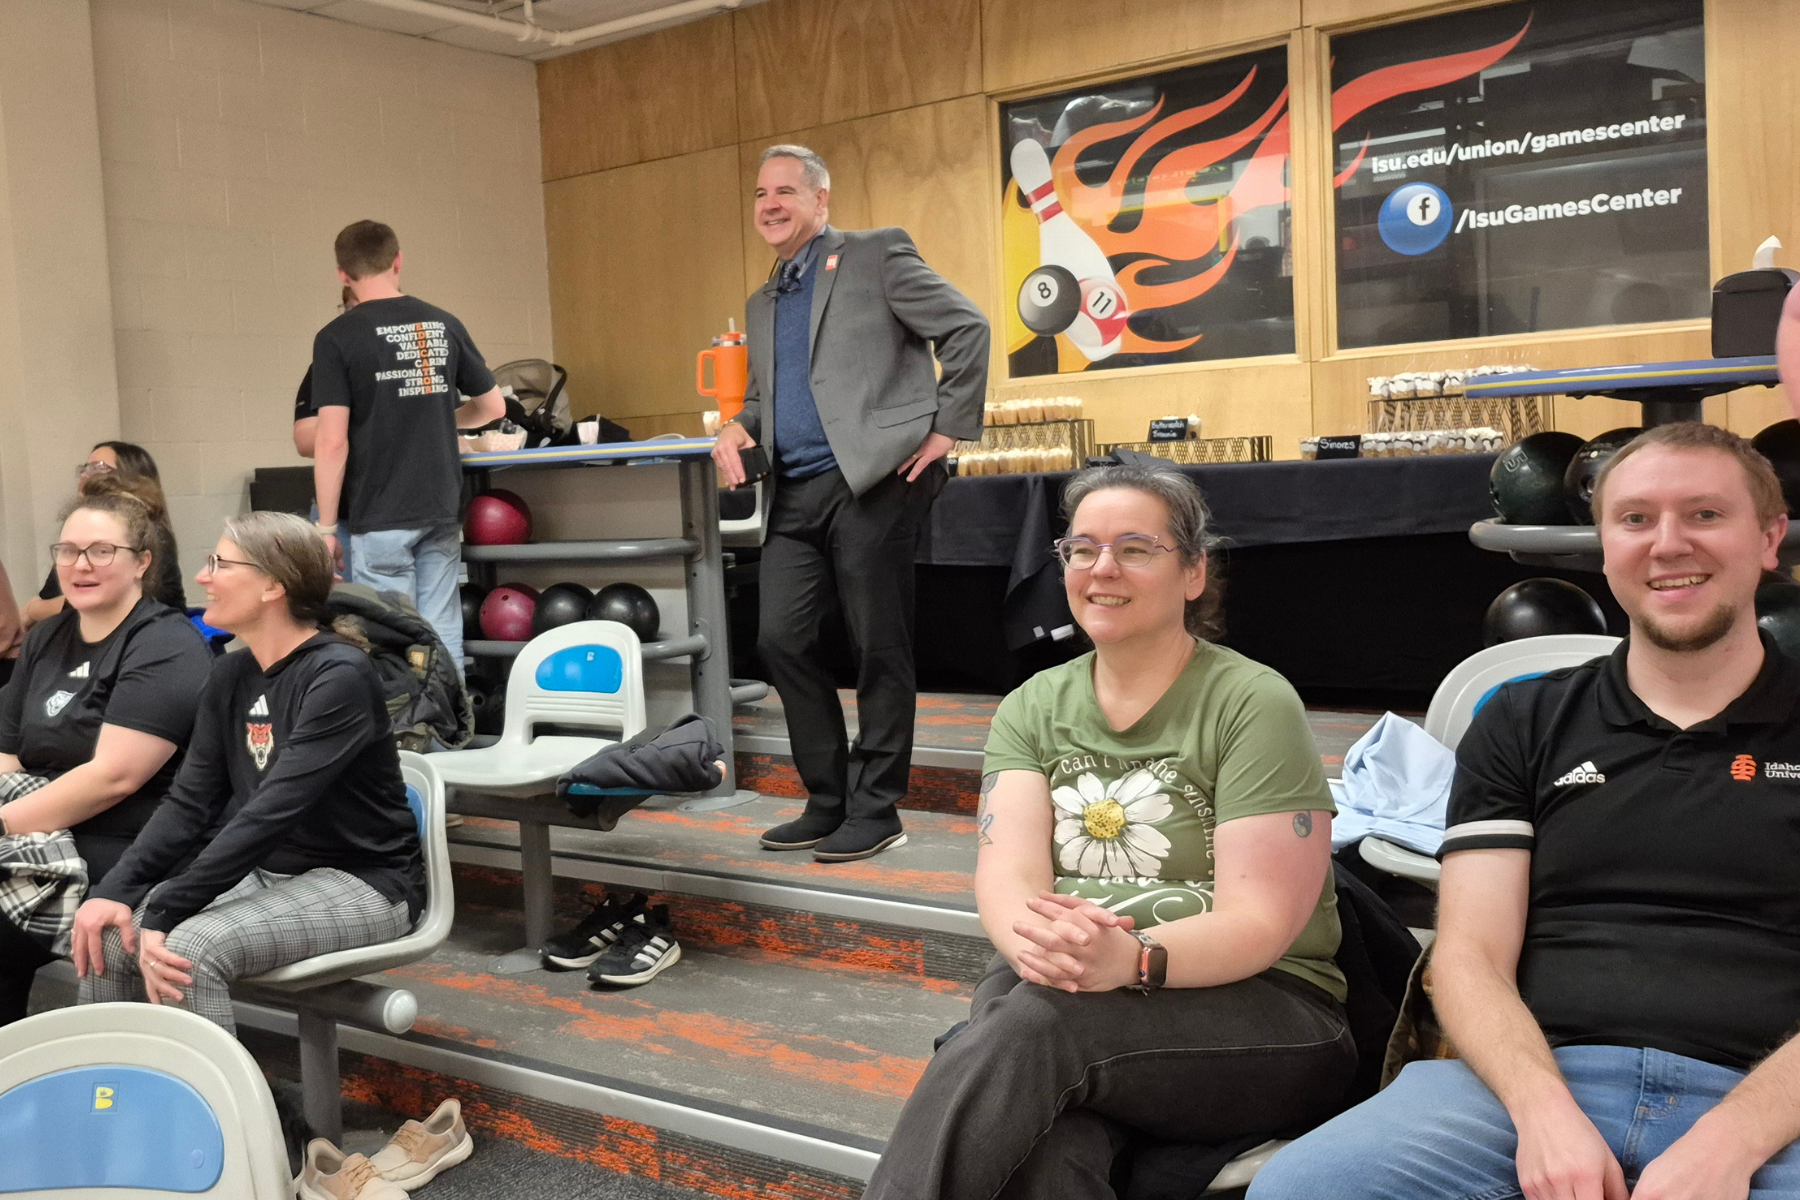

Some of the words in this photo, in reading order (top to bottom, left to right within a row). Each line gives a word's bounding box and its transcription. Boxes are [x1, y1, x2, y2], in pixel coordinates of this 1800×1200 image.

[1372, 114, 1686, 174] isu.edu/union/gamescenter
[1455, 187, 1682, 234] /IsuGamesCenter
[1037, 281, 1052, 299] 8
[1091, 290, 1112, 315] 11
[376, 322, 446, 336] EMPOWERING
[386, 331, 444, 343] CONFIDENT
[399, 339, 448, 351] VALUABLE
[396, 348, 449, 361] DEDICATED
[414, 357, 447, 367] CARIN
[375, 367, 436, 382] PASSIONATE
[405, 376, 445, 387] STRONG
[398, 384, 449, 397] INSPIRING
[1553, 770, 1606, 787] adidas
